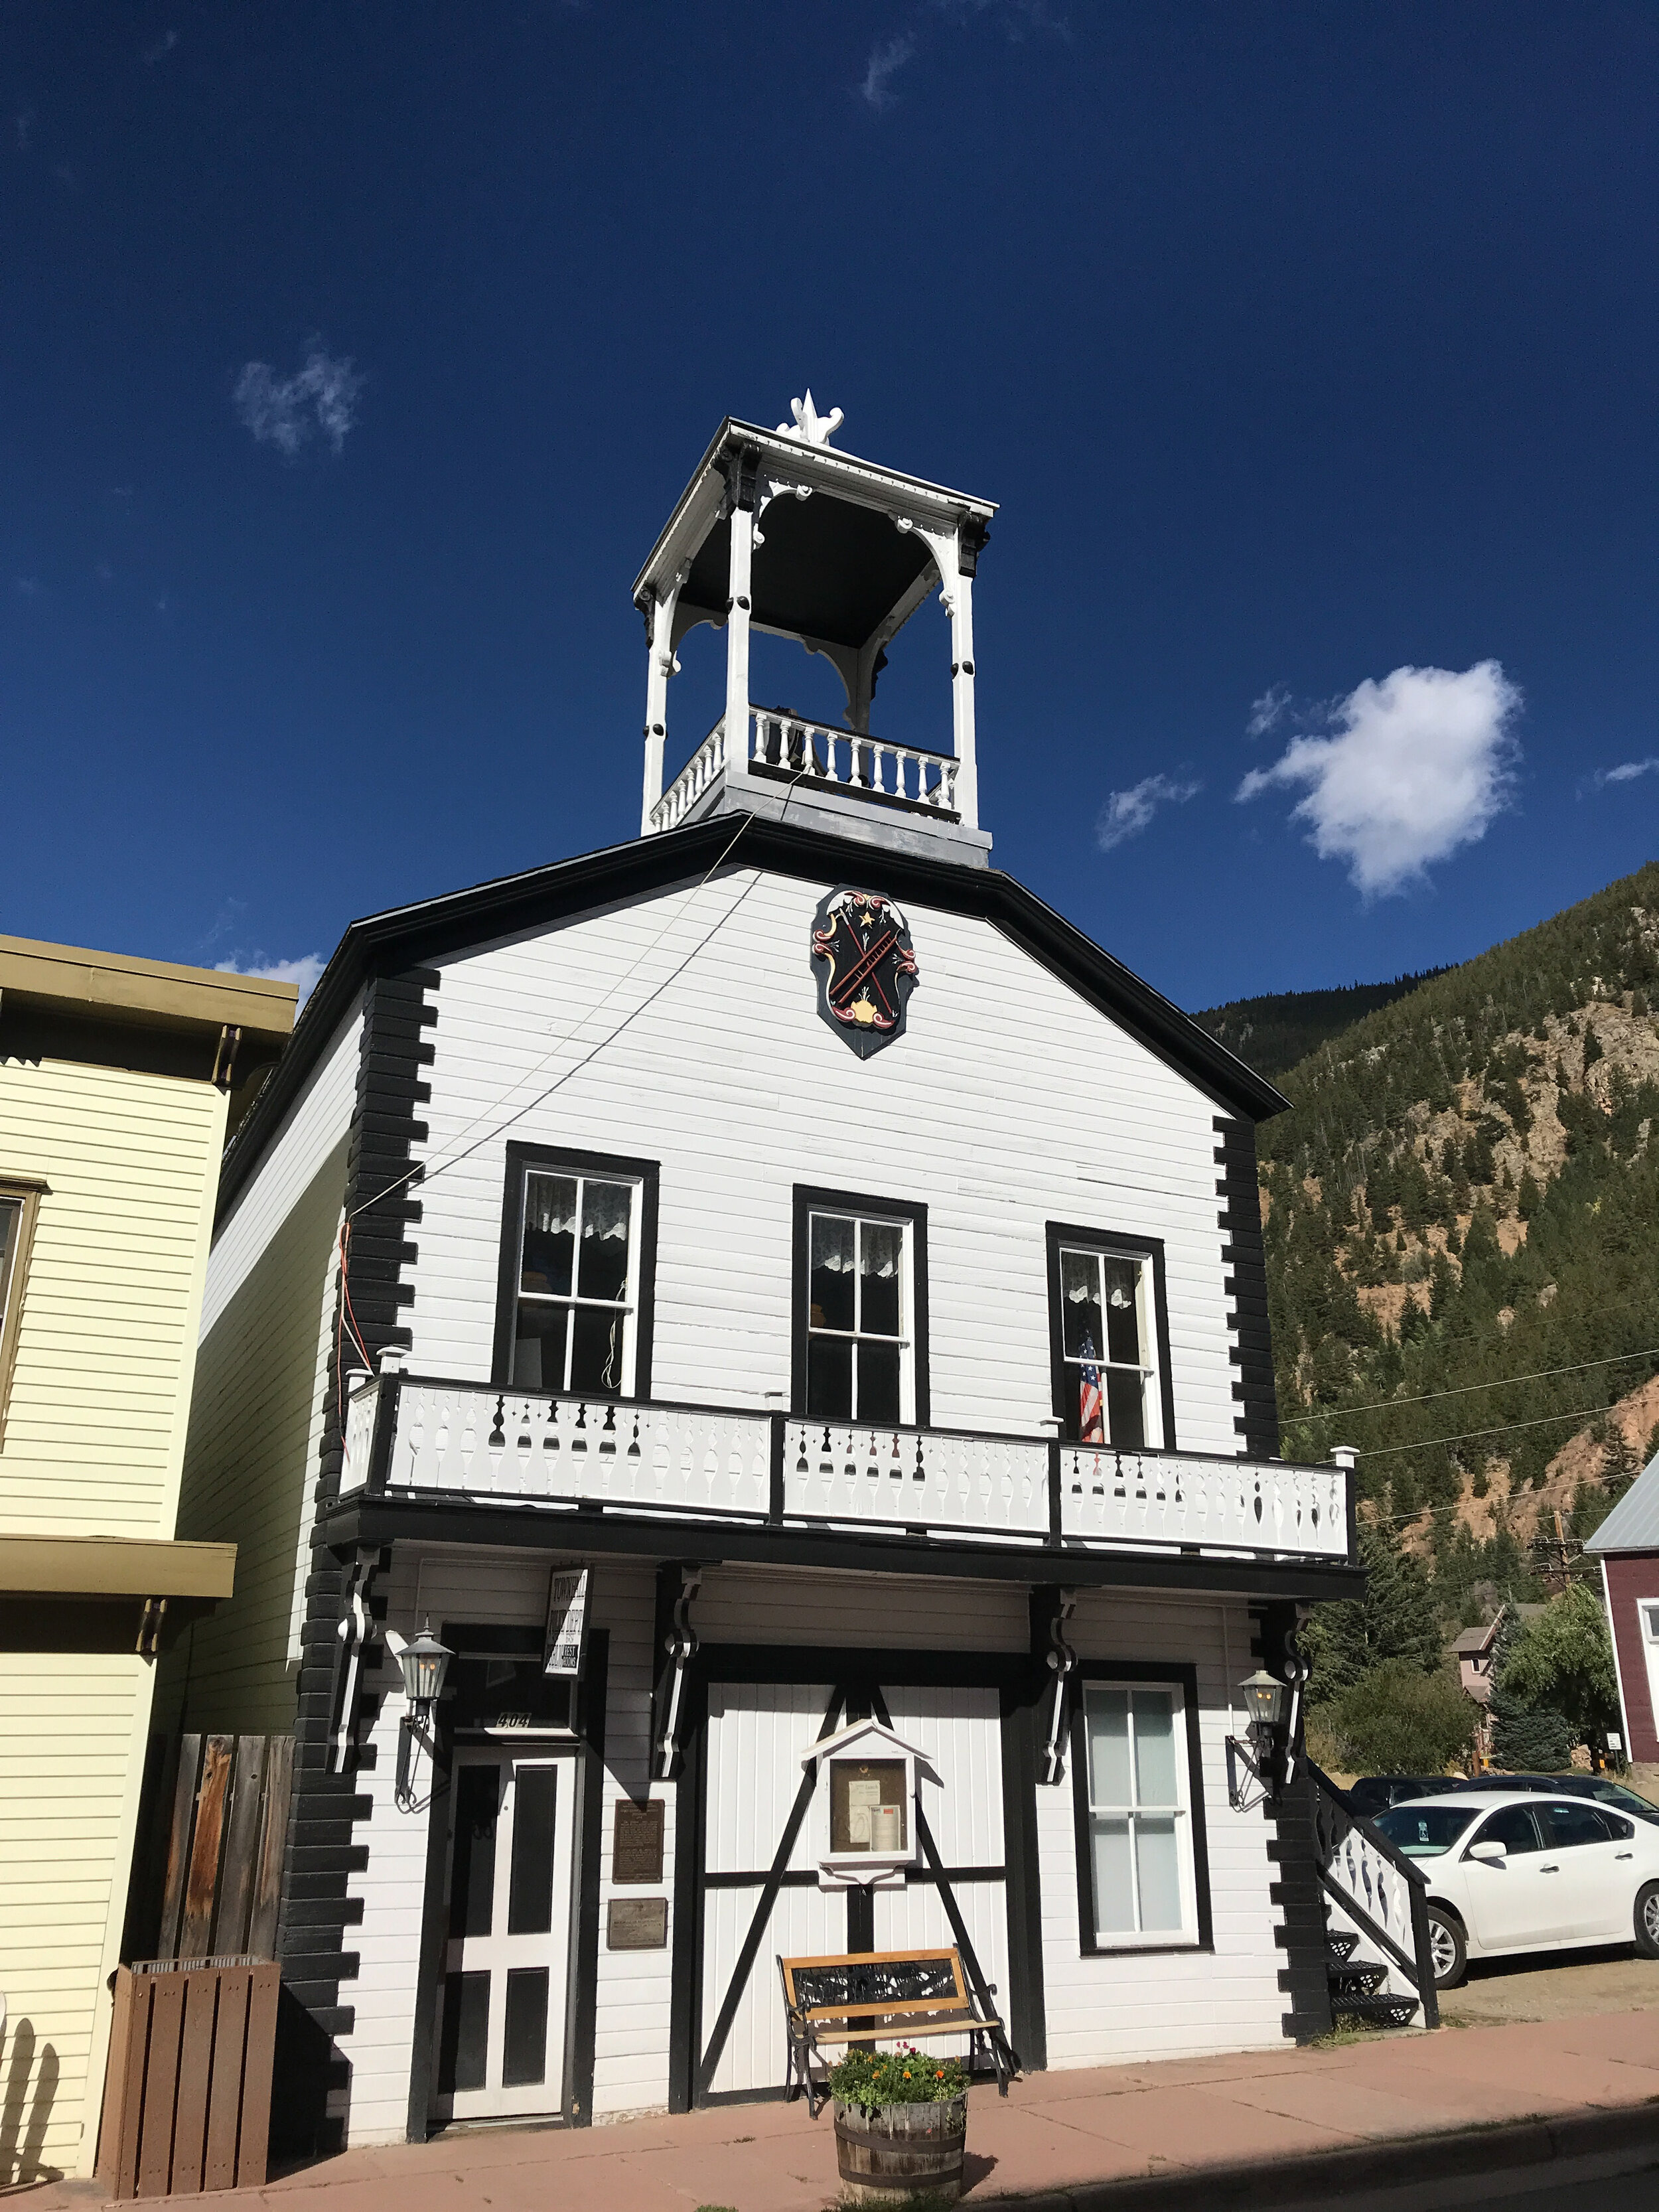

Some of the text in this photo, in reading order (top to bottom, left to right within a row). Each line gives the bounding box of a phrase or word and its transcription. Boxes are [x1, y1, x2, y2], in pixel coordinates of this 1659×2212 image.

[553, 1575, 585, 1602] TOWN HALL
[564, 1646, 576, 1657] REST
[562, 1657, 577, 1667] ROOMS
[498, 1713, 530, 1727] 404
